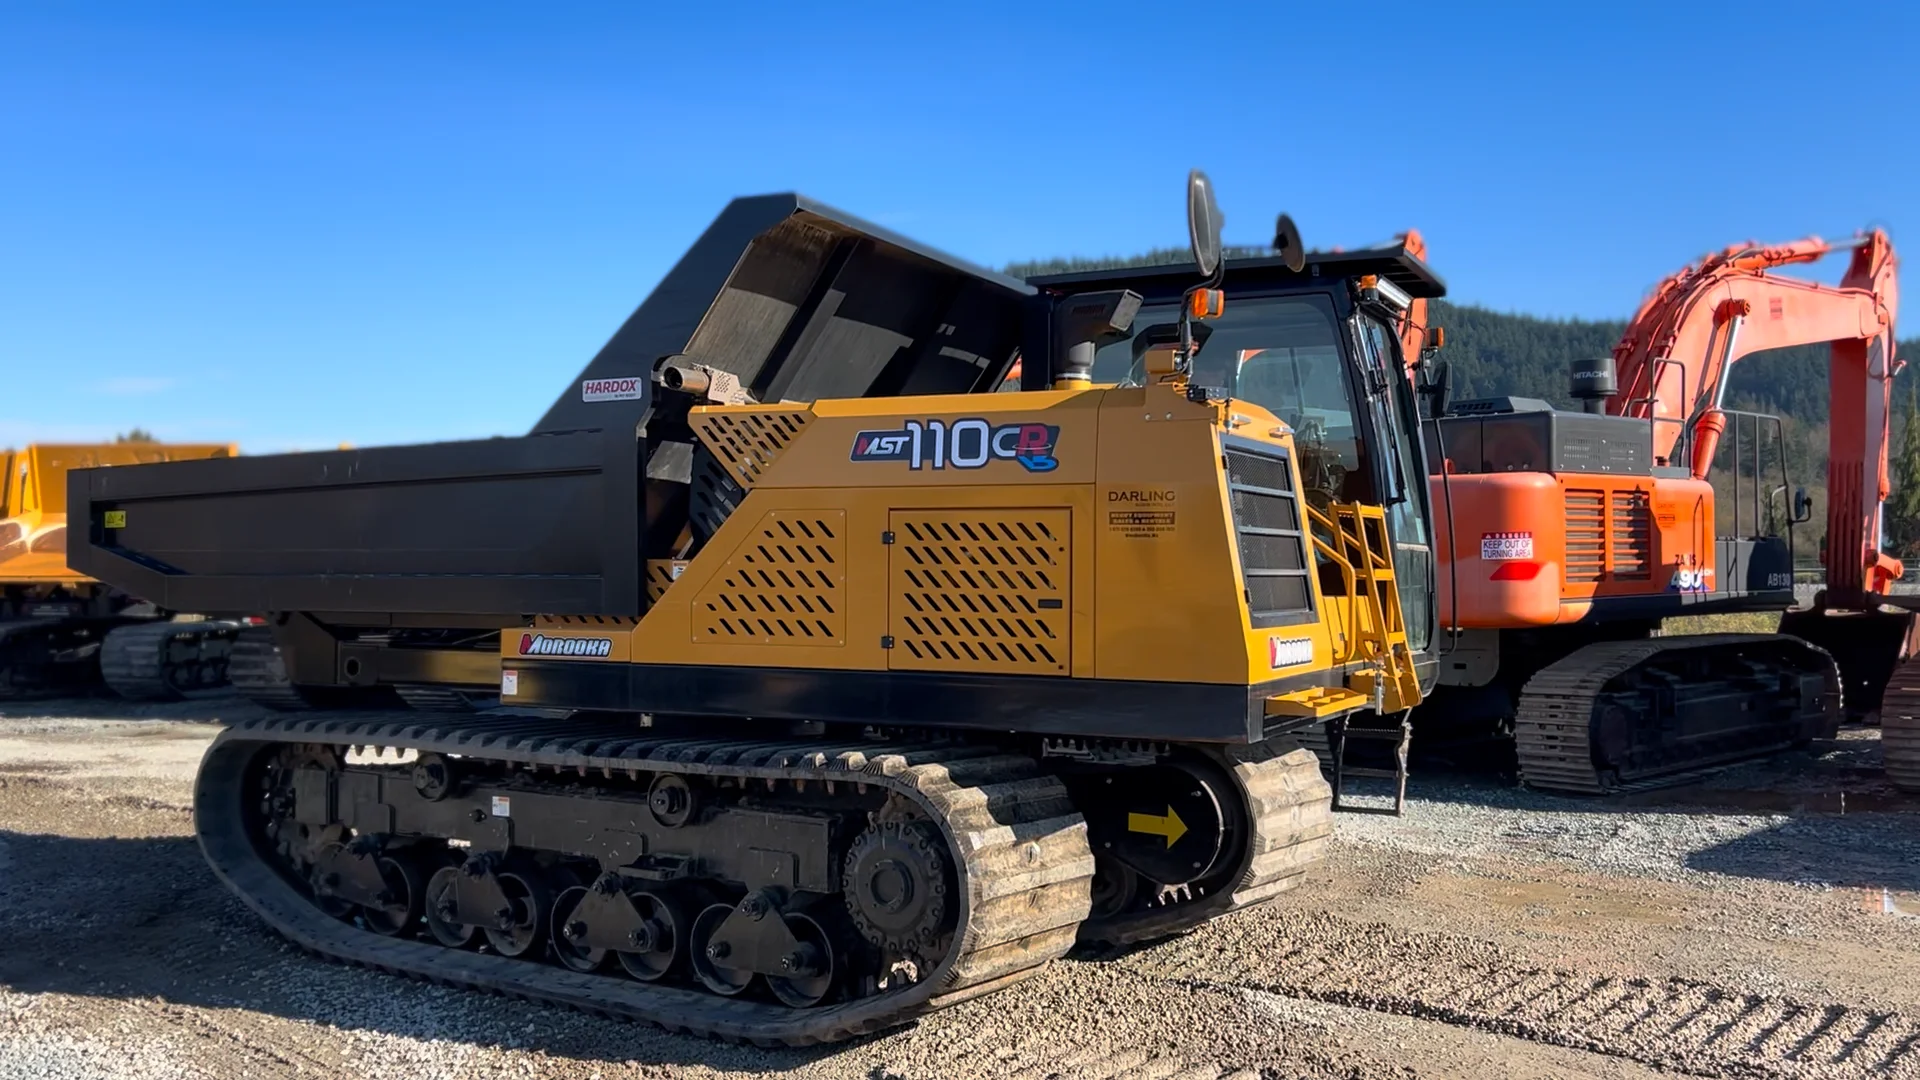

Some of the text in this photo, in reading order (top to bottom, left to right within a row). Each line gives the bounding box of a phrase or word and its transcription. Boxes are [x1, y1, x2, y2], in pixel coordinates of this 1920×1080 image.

[1573, 371, 1609, 379] HITACHI
[585, 380, 636, 394] HARDOX
[1108, 491, 1175, 501] DARLING
[1483, 540, 1531, 549] KEEP OUT OF
[1483, 549, 1531, 558] TURNING AREA
[520, 634, 611, 656] MOROOKA
